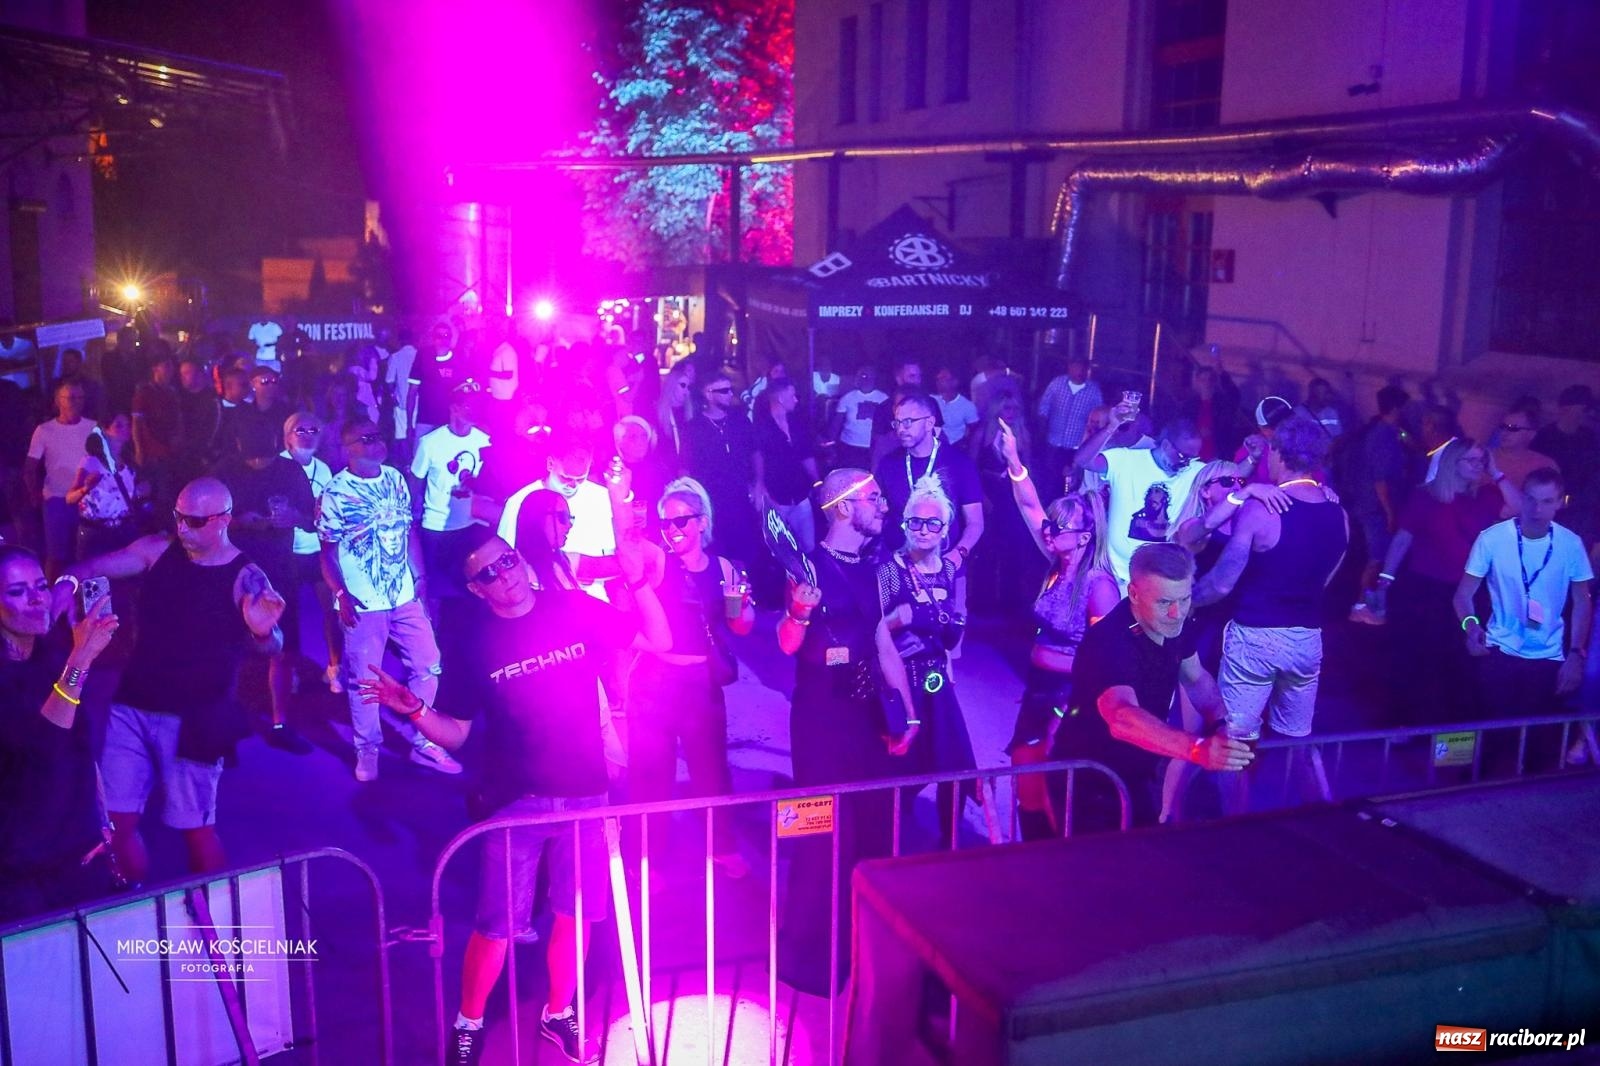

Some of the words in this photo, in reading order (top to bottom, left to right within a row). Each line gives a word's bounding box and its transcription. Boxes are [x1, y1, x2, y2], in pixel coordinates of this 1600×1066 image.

[819, 306, 863, 317] IMPREZY
[874, 305, 949, 316] KONFERANSJER
[960, 305, 972, 316] DJ
[989, 305, 1007, 317] +48
[1050, 307, 1068, 318] 223
[324, 323, 374, 340] FESTIVAL
[490, 642, 585, 683] TECHNO
